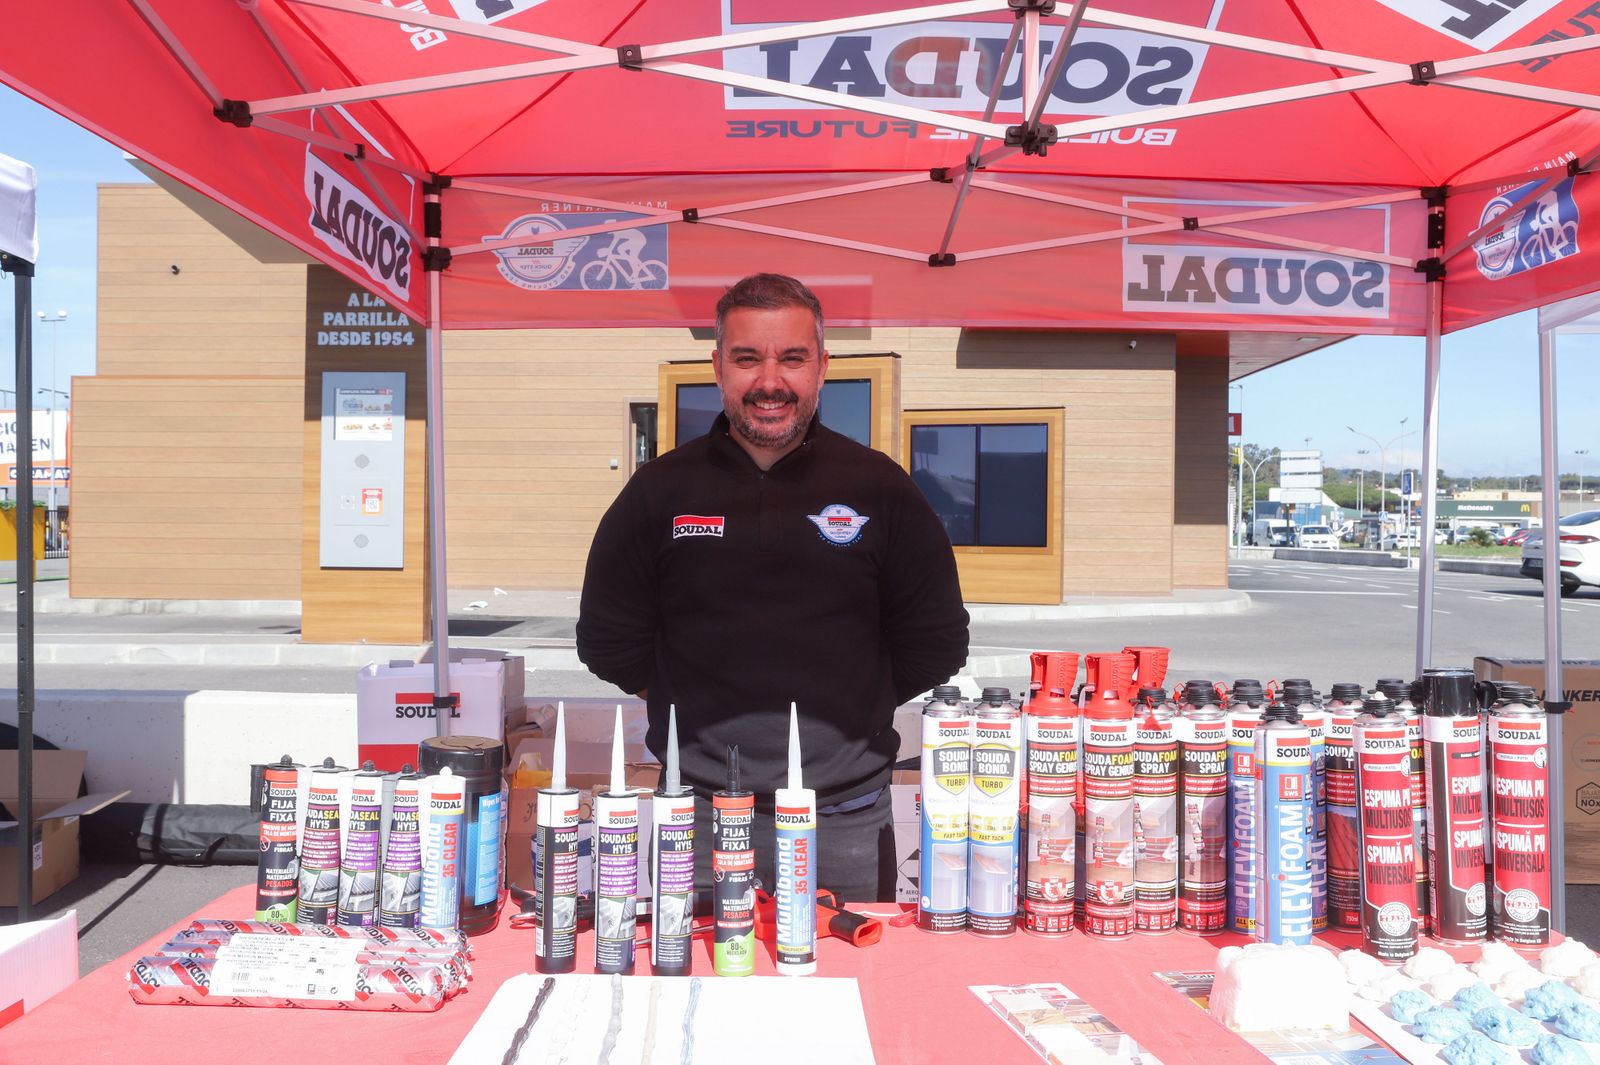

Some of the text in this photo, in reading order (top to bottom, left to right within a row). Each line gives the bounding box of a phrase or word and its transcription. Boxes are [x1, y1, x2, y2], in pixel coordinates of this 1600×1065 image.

[347, 293, 386, 307] A LA
[323, 312, 410, 326] PARRILLA
[317, 332, 415, 346] DESDE 1954
[673, 523, 721, 537] SOUDAL
[396, 706, 460, 718] SOUDL
[976, 730, 1011, 739] SOUDAL
[1038, 730, 1073, 738] SOUDAL
[1090, 732, 1127, 742] SOUDAL
[1137, 730, 1172, 739] SOUDAL
[1498, 729, 1541, 740] SOUDAL
[1365, 740, 1406, 749] SOUDAL
[976, 751, 1011, 763] SOUDA
[1029, 761, 1055, 774] SPRAY
[1085, 763, 1107, 776] SPRAY
[1141, 762, 1169, 774] SPRAY
[1200, 762, 1225, 774] SPRAY
[946, 778, 966, 787] TURBO
[981, 780, 1004, 789] TURBO
[1496, 778, 1545, 797] ESPUMA PU
[1364, 788, 1400, 808] ESPUMA
[270, 799, 295, 809] FIJA
[430, 801, 462, 809] OUDAL
[1496, 798, 1545, 818] MULTIUSOS
[269, 812, 295, 822] FIXA
[721, 816, 751, 824] SOUDAL
[776, 814, 811, 823] SOUDAL
[309, 821, 330, 829] HY15
[397, 821, 417, 831] HY15
[722, 828, 745, 838] FIJA
[612, 843, 633, 854] HY15
[674, 839, 692, 851] HY15
[722, 841, 745, 851] FIXA
[1535, 834, 1546, 853] PU
[443, 822, 458, 878] 35 CLEAR
[794, 837, 808, 895] 35 CLEAR
[1280, 804, 1312, 938] FLEXIFOAM
[265, 880, 292, 888] PESADOS
[776, 837, 792, 943] Multibond
[723, 911, 750, 919] PESADOS
